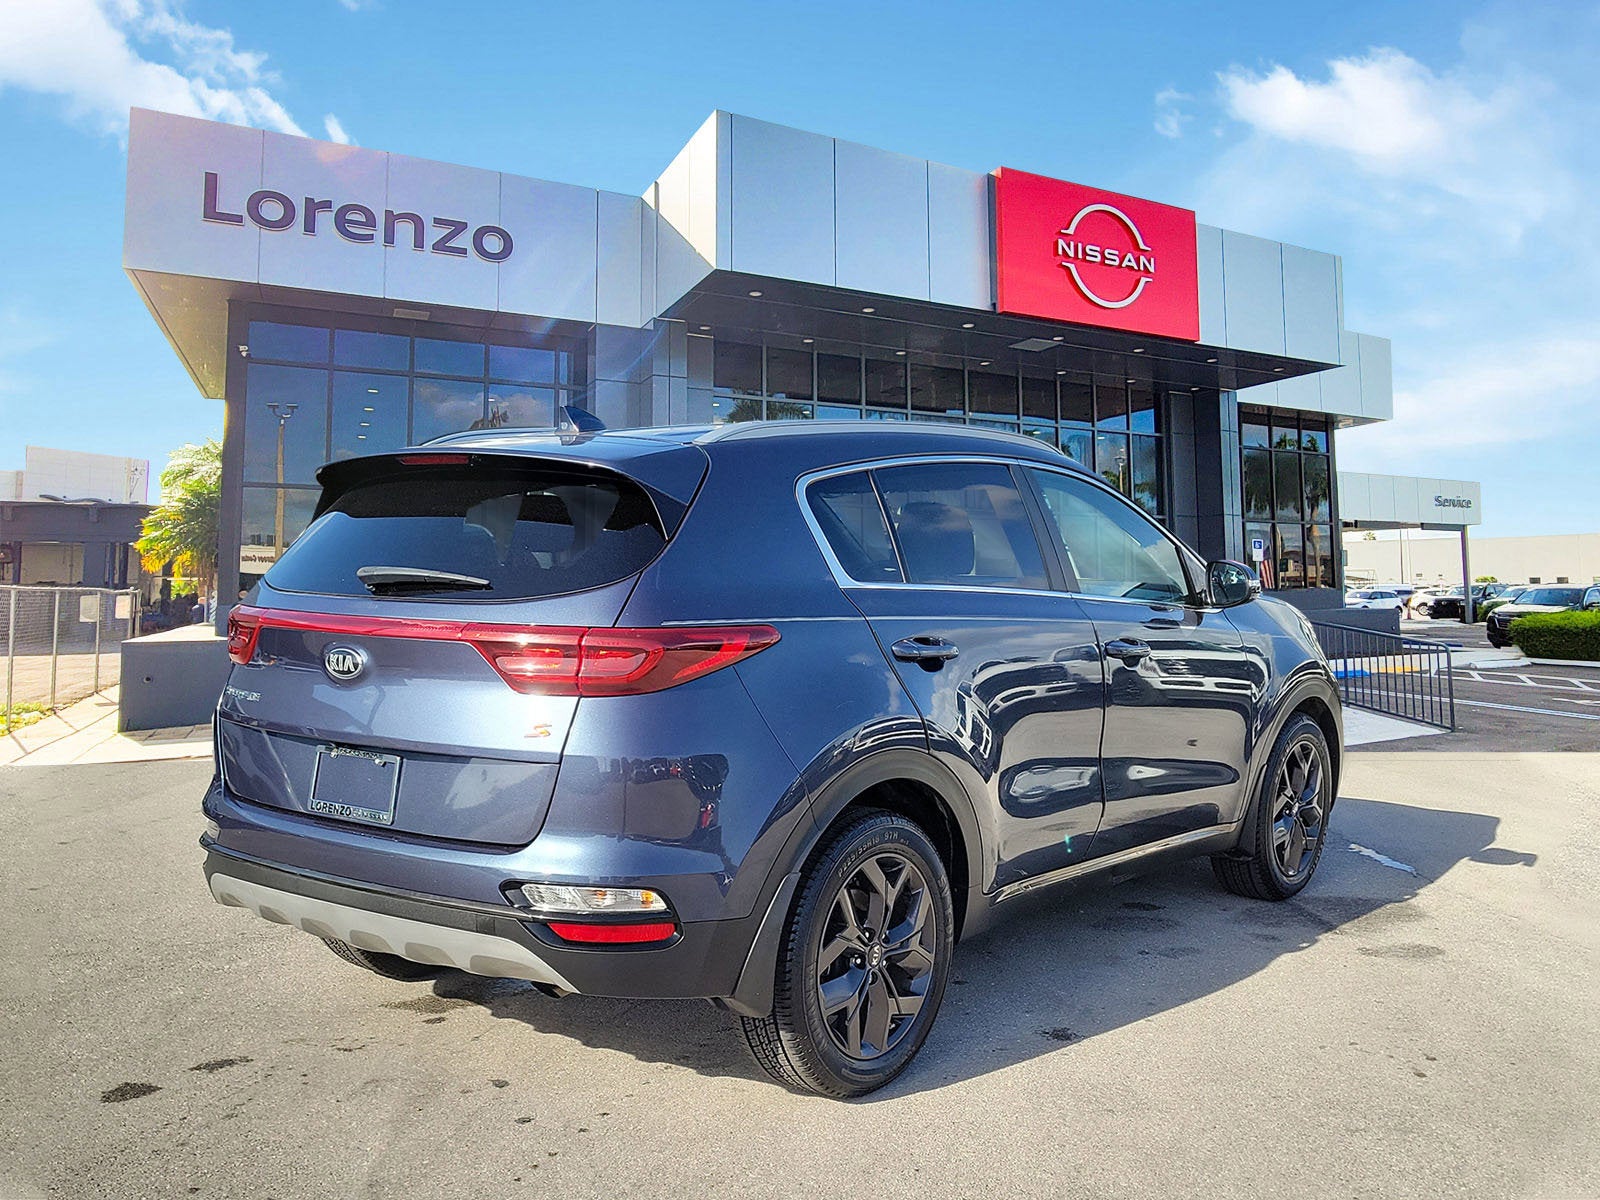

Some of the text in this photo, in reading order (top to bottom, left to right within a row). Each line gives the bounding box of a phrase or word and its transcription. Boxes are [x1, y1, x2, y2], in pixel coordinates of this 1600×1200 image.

[202, 171, 514, 262] Lorenzo
[1057, 238, 1155, 273] NISSAN
[1434, 495, 1472, 509] Service
[329, 653, 355, 671] KIA
[310, 800, 352, 816] LORENZO
